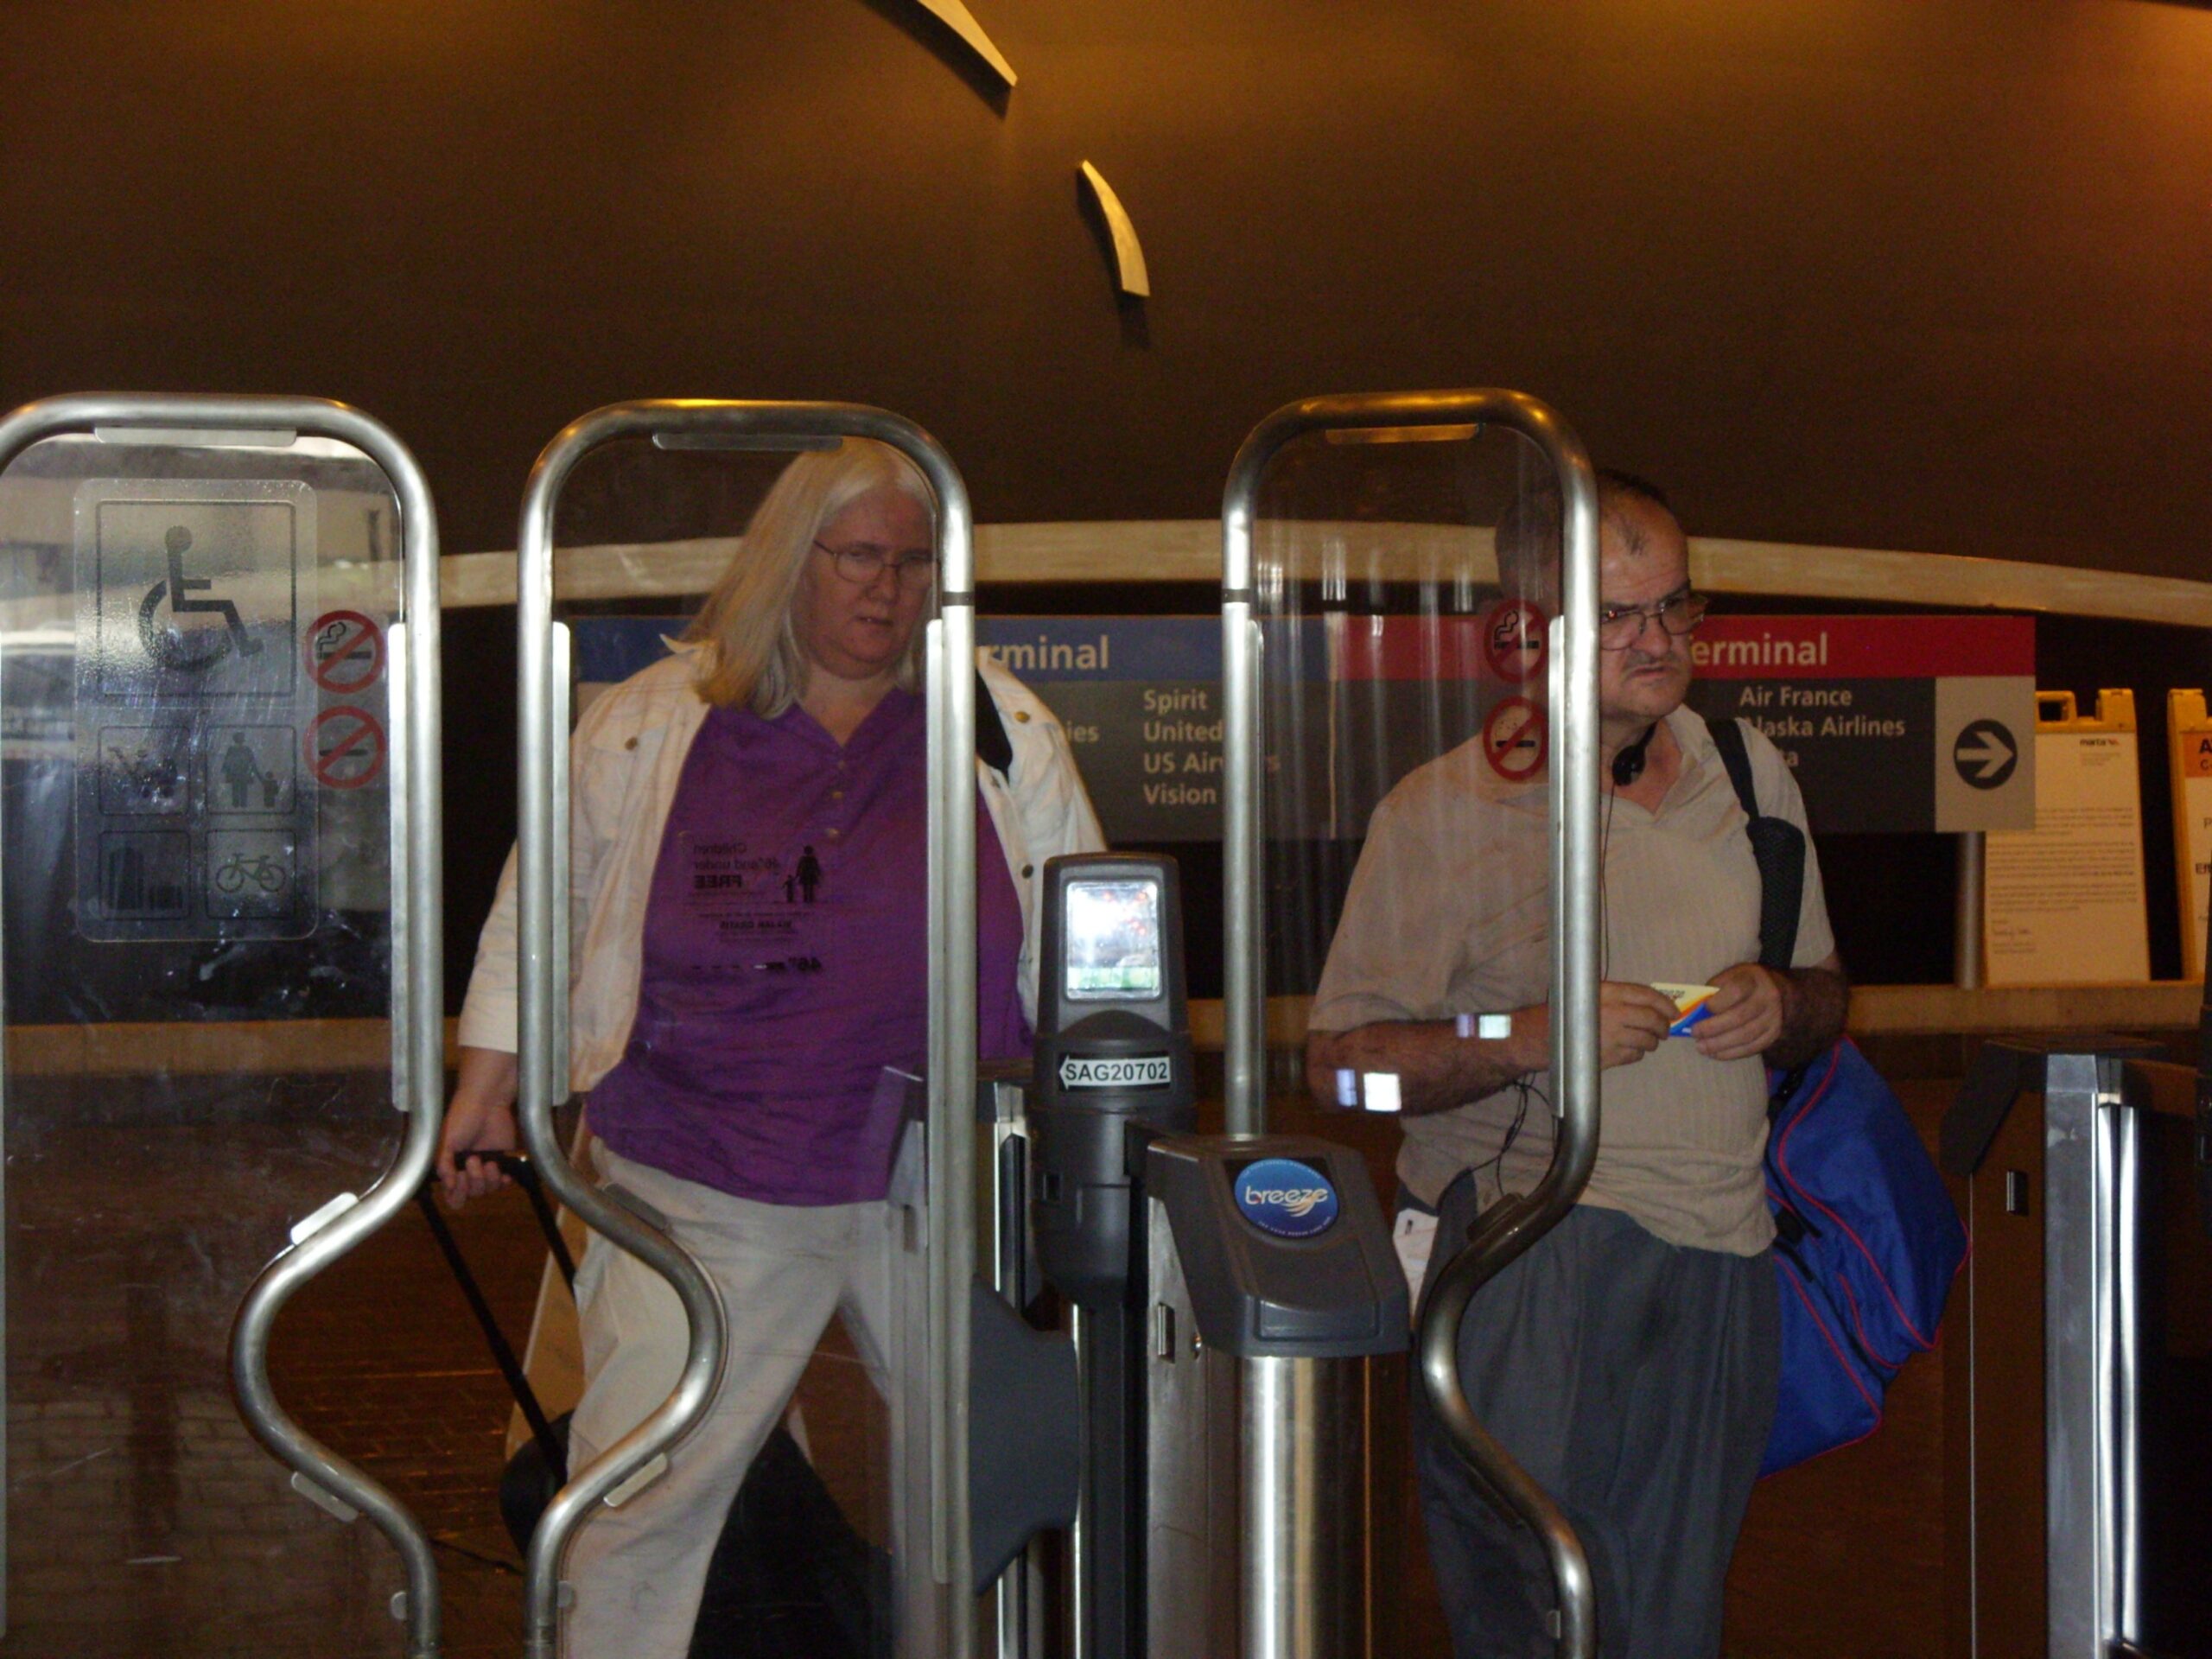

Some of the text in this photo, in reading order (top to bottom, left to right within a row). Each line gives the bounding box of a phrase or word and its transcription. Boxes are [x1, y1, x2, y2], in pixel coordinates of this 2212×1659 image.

[991, 635, 1109, 670] rminal
[1689, 632, 1827, 666] erminal
[1143, 690, 1207, 715] Spirit
[1739, 686, 1853, 707] Air France
[1143, 720, 1224, 743] United
[1821, 715, 1906, 736] Airlines
[1143, 752, 1175, 774] US
[1143, 783, 1217, 805] Vision
[1065, 1062, 1168, 1082] SAG20702
[1244, 1185, 1329, 1205] breeze
